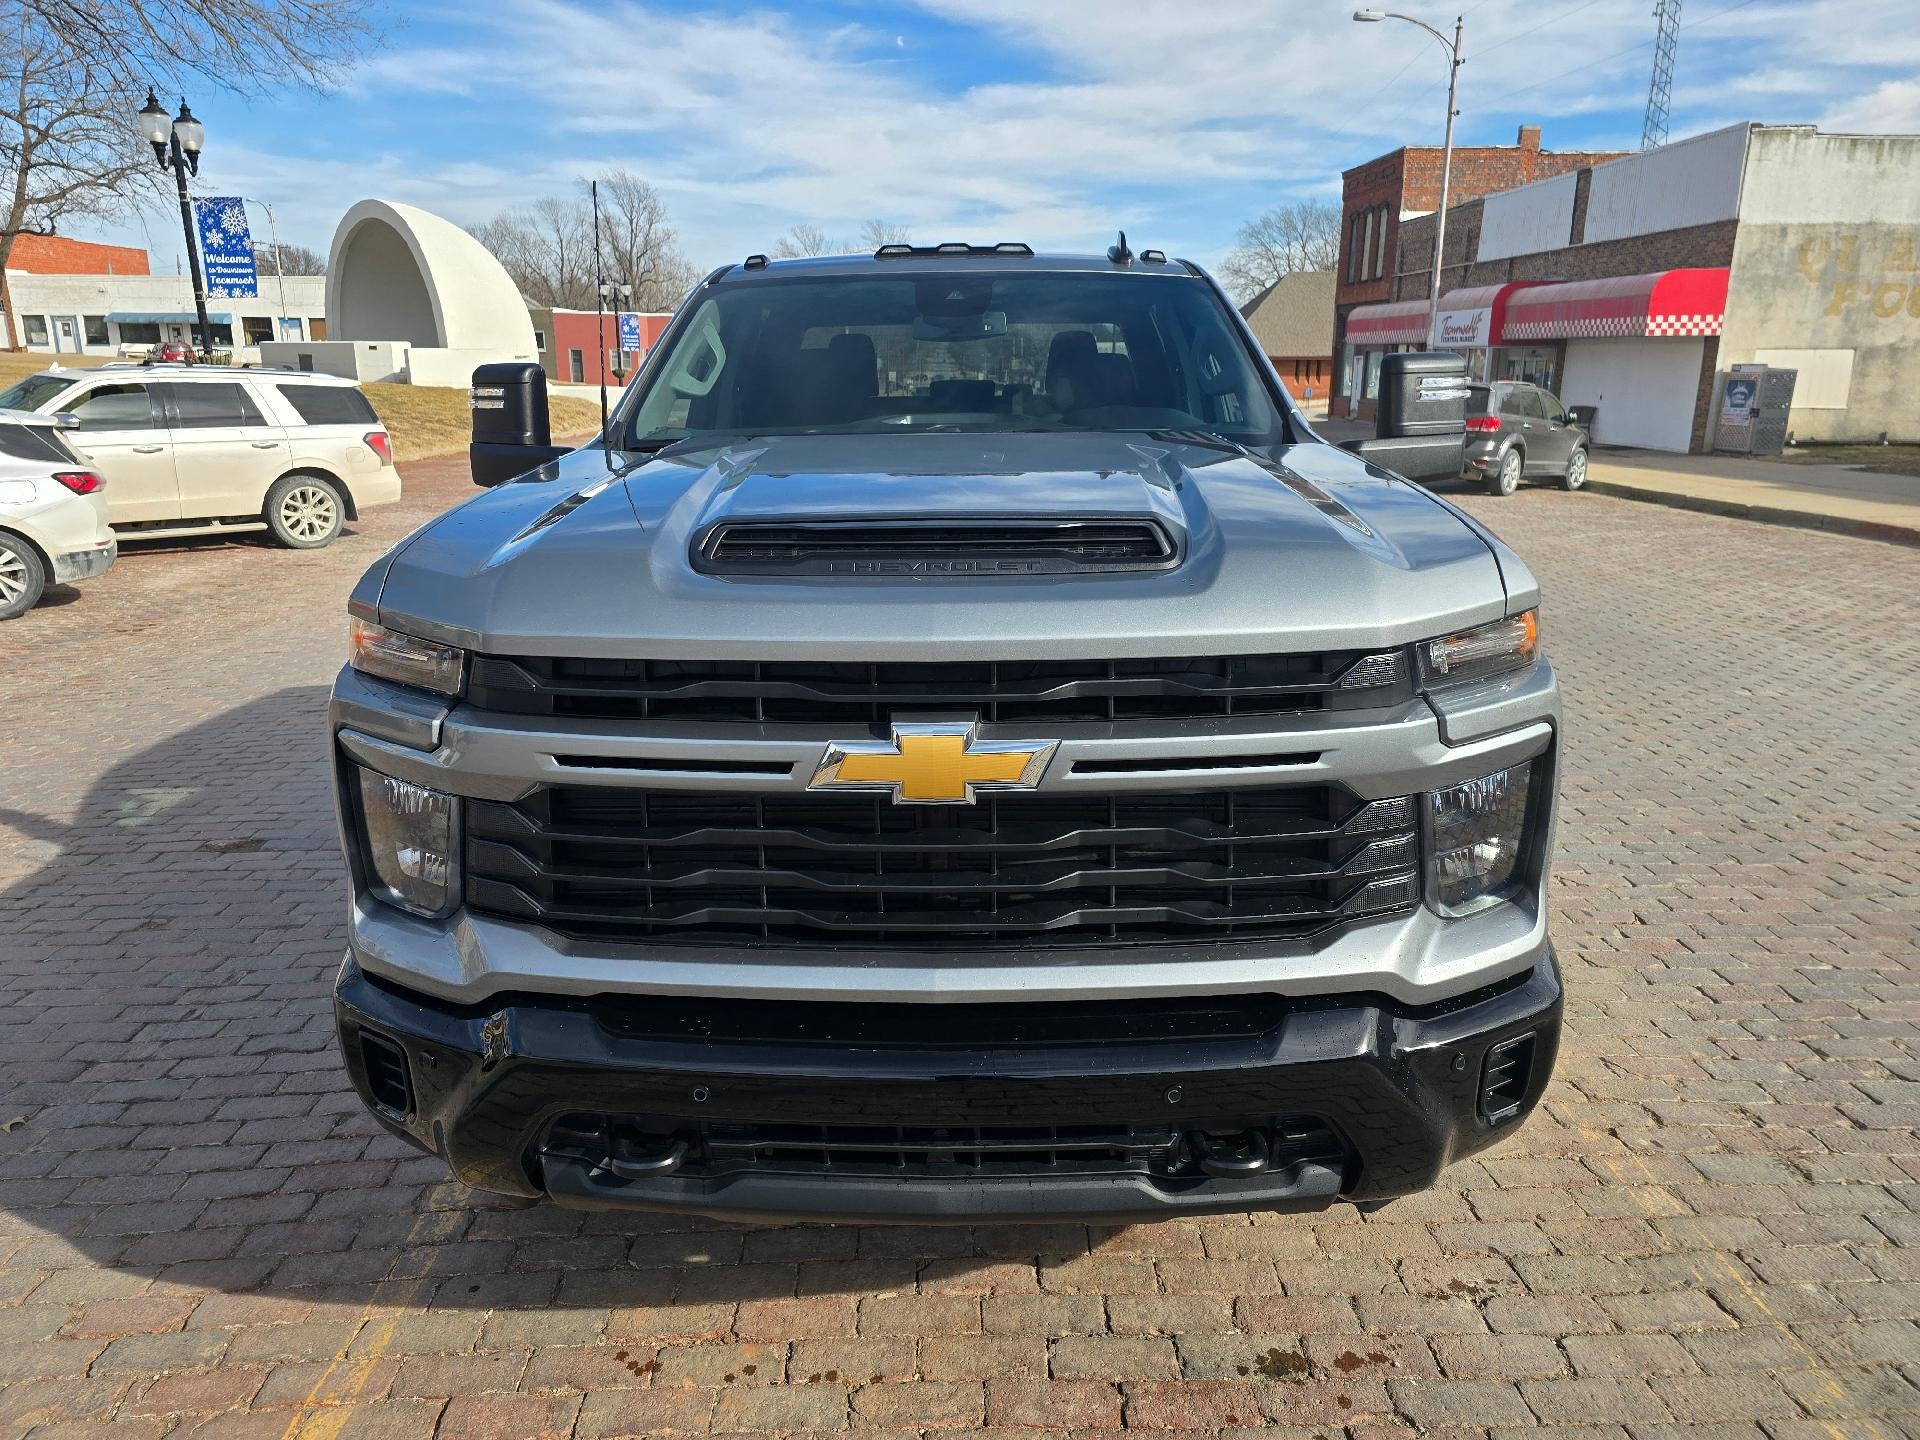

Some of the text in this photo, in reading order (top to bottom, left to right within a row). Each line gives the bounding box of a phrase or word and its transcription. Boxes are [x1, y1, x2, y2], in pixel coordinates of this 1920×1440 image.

[205, 253, 251, 263] Welcome
[210, 275, 255, 284] Tecumseh
[829, 561, 1041, 572] CHEVROLET
